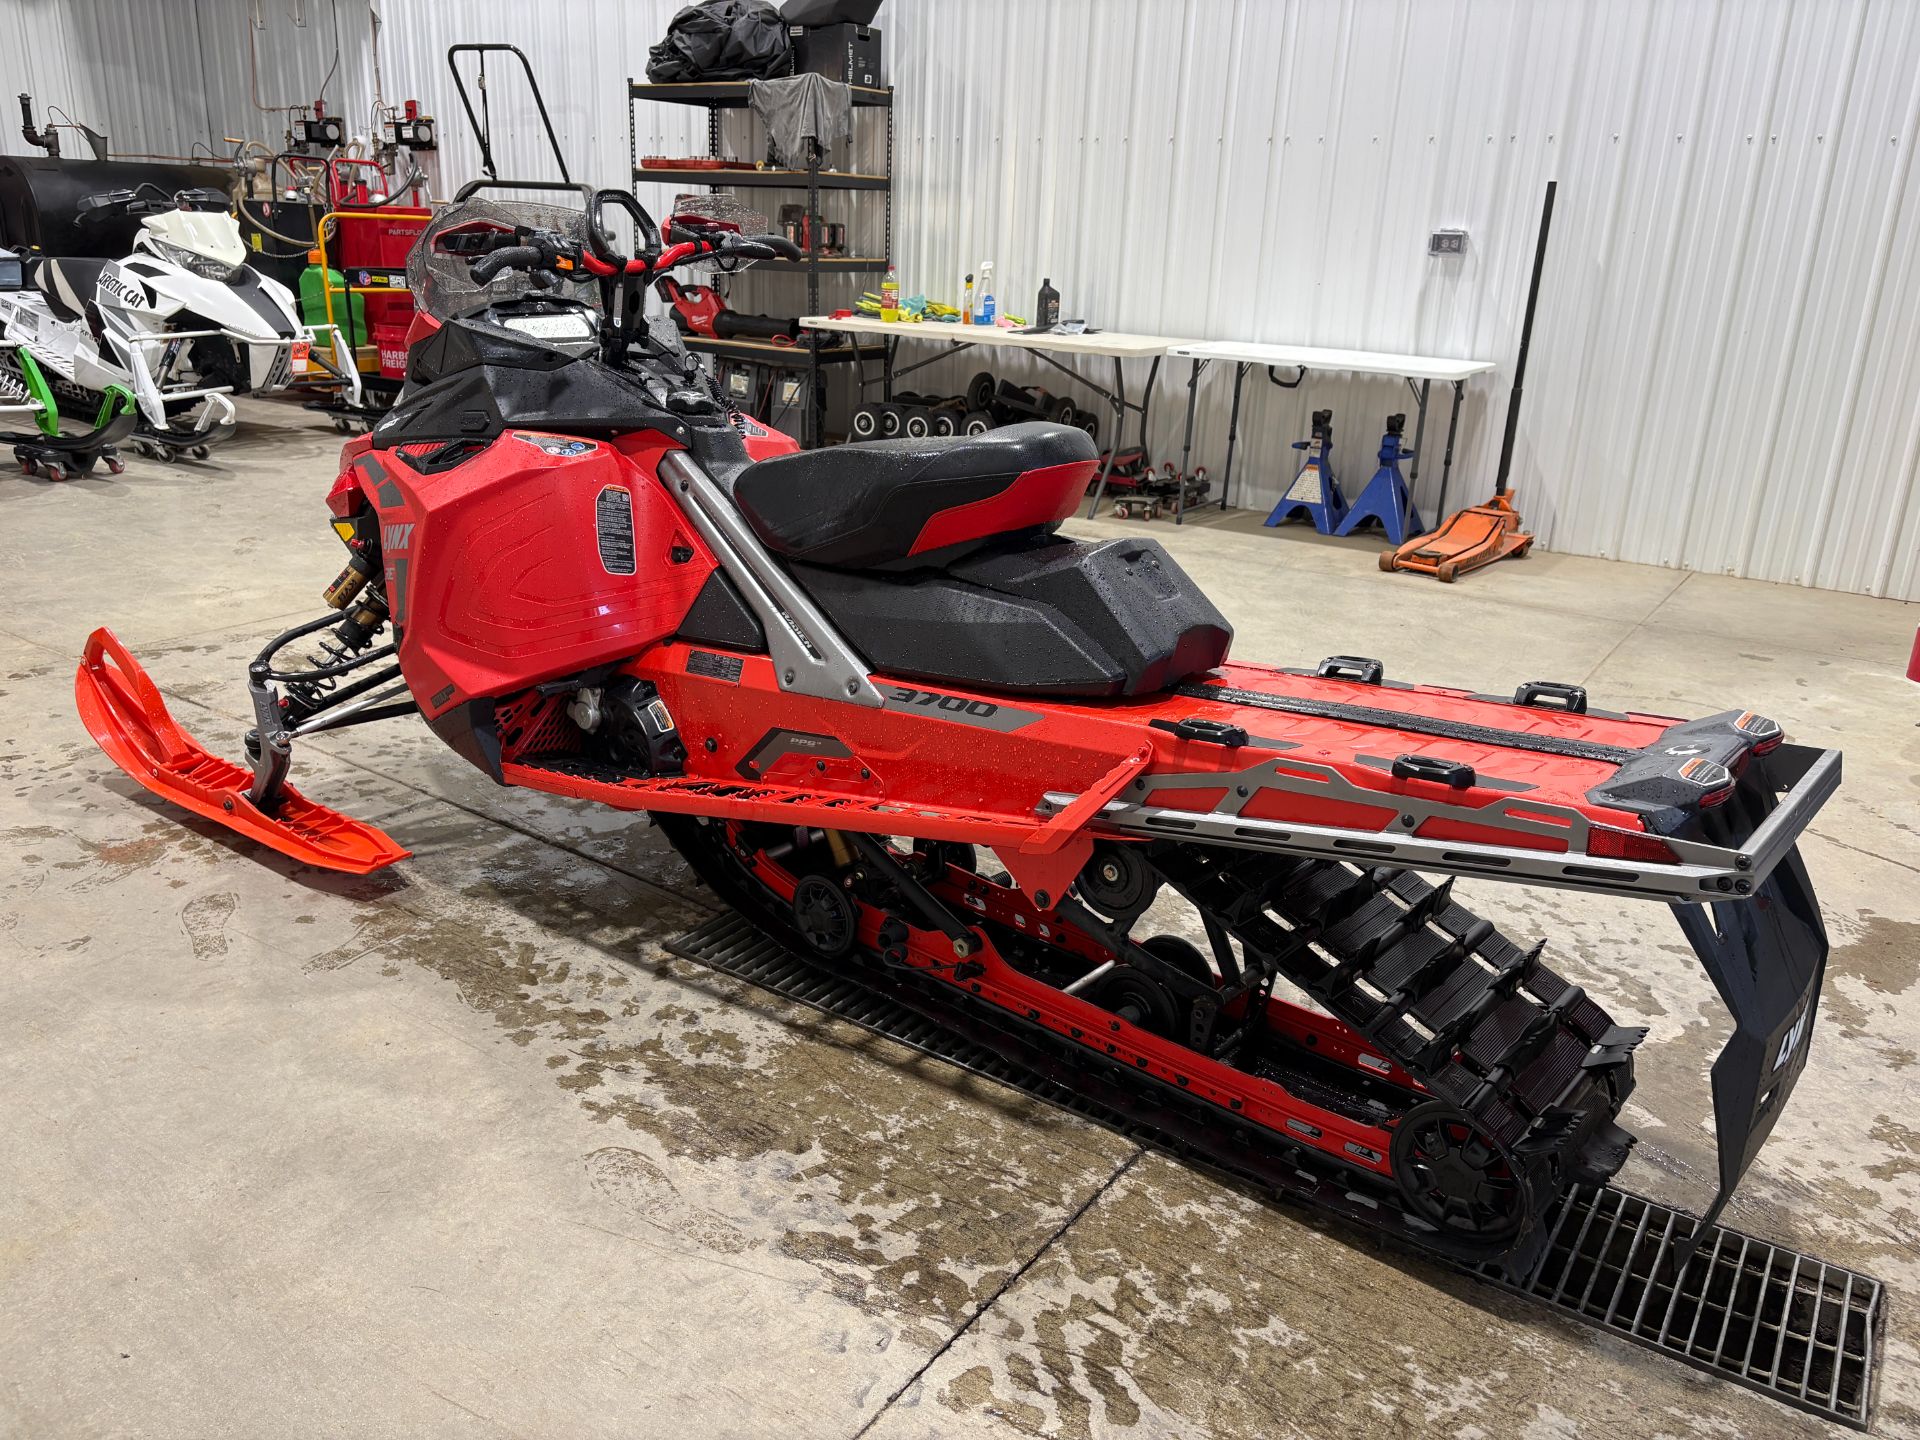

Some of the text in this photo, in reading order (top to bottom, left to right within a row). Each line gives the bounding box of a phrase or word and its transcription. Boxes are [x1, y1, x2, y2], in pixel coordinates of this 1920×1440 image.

[98, 273, 145, 309] ARCTIC CAT
[383, 523, 416, 553] LYNX
[781, 611, 813, 649] RADIEN
[888, 686, 998, 718] 3700
